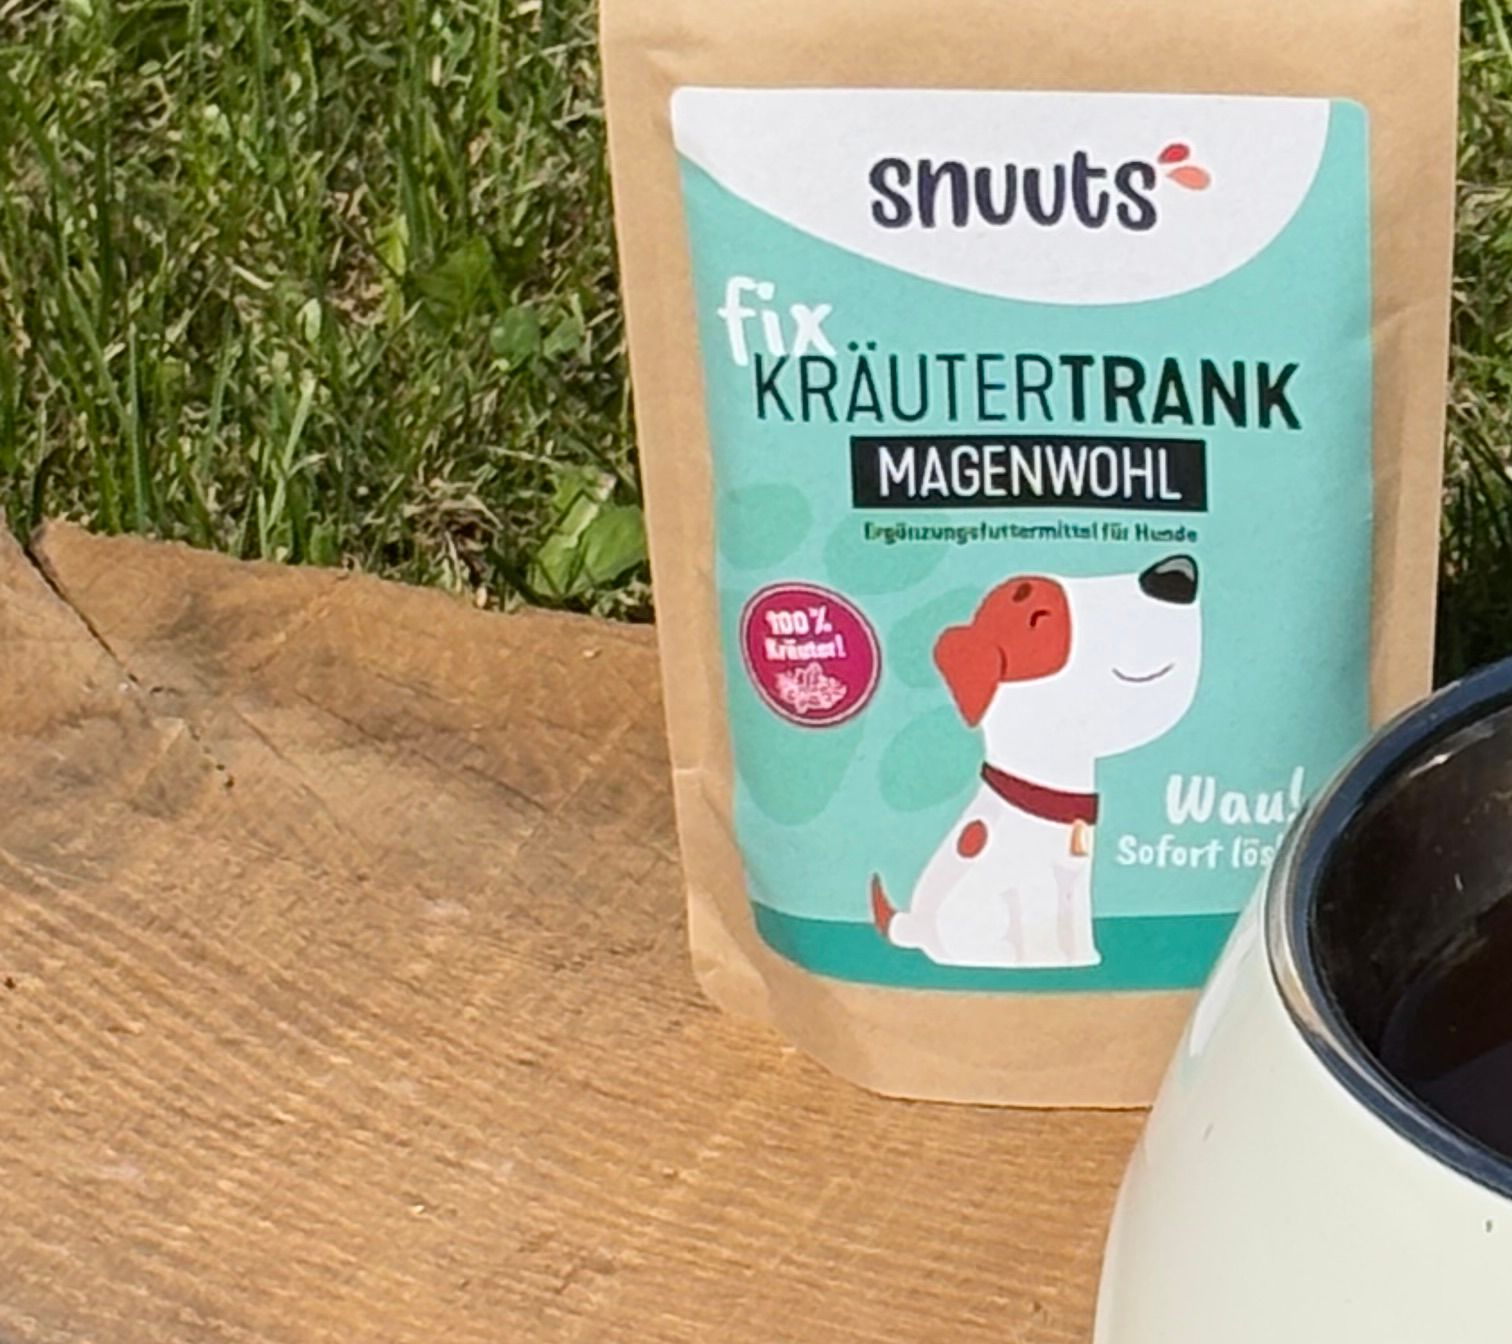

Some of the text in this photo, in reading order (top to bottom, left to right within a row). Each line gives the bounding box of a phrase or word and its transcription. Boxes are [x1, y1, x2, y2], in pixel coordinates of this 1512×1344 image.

[869, 150, 1157, 231] snuuts
[717, 276, 837, 366] fix
[754, 341, 1302, 430] KRÄUTERTRANK
[878, 444, 1183, 501] MAGENWOHL
[864, 520, 1198, 545] Ergänzungsfuttermittel für Hunde
[1166, 765, 1305, 825] Wau!
[1116, 831, 1285, 869] Sofort lös
